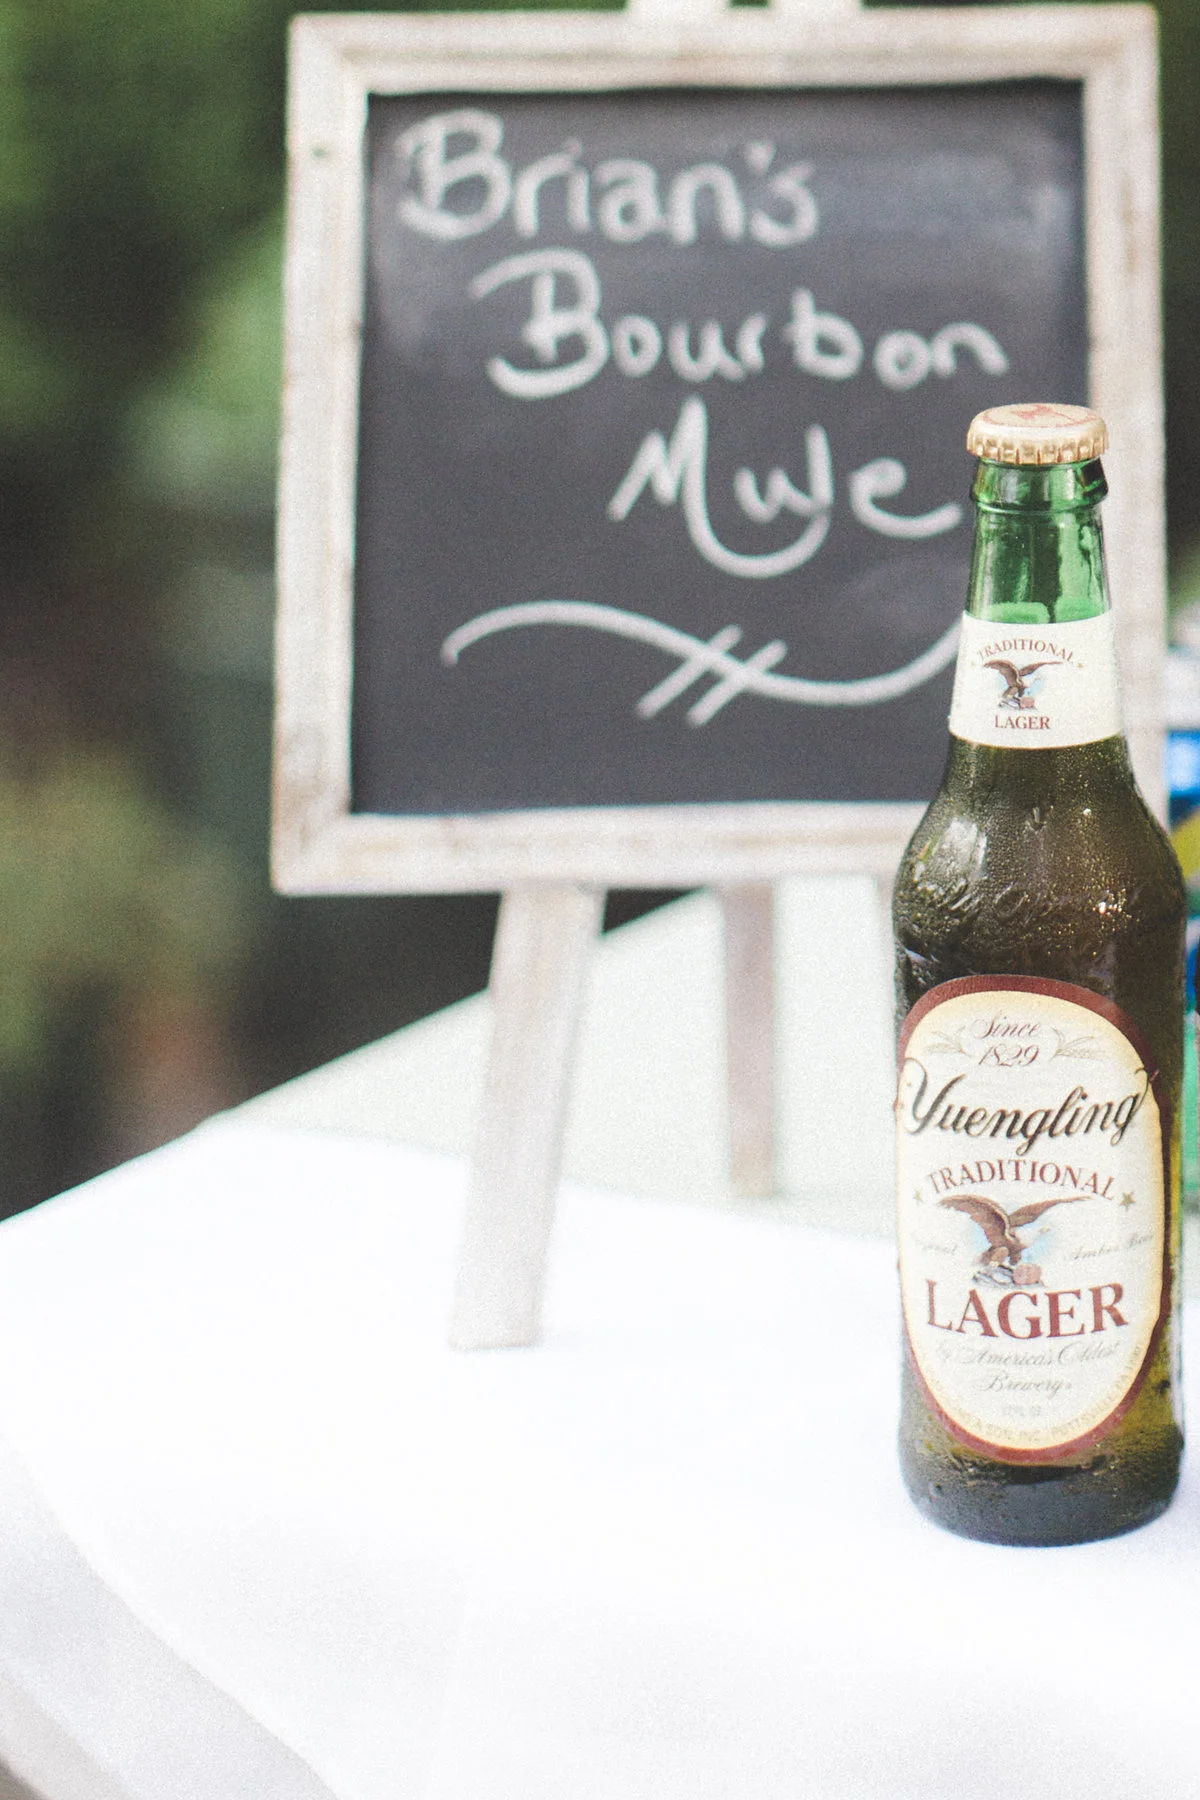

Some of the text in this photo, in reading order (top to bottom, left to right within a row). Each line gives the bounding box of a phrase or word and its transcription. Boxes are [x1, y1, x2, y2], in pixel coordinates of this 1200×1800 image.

[397, 108, 820, 250] Brian's
[468, 247, 1009, 399] Bourbon
[607, 396, 963, 578] Mule
[978, 638, 1075, 664] TRADITIONAL
[994, 715, 1051, 730] LAGER
[975, 1011, 1042, 1038] Since
[978, 1044, 1040, 1067] 1829
[902, 1057, 1156, 1156] Yuengling
[927, 1159, 1116, 1200] TRADITIONAL
[926, 1279, 1129, 1340] LAGER
